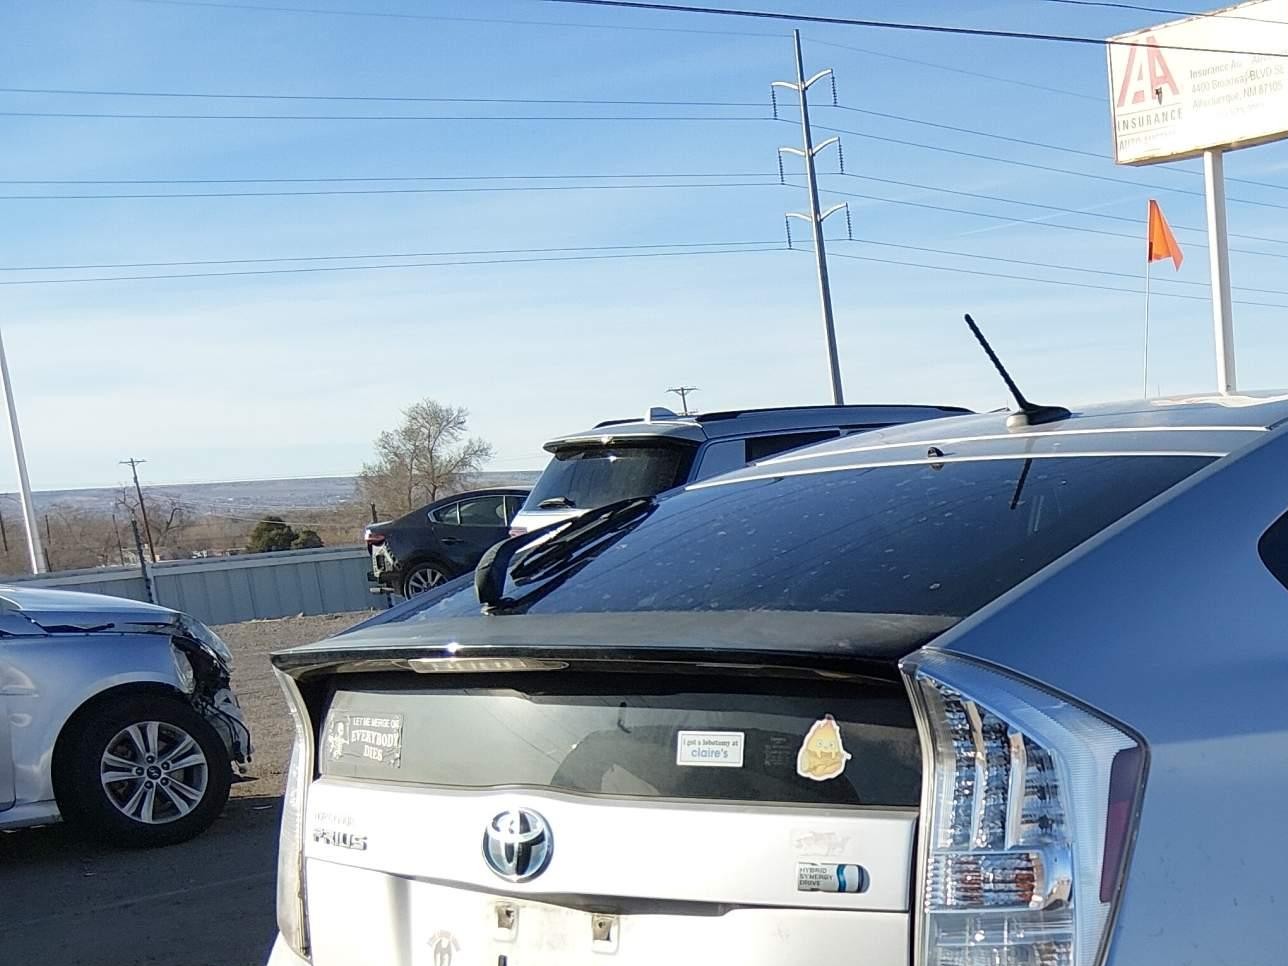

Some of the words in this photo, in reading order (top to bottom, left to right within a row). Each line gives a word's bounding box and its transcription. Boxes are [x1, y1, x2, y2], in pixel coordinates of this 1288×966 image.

[1189, 63, 1229, 80] Insurance
[1249, 66, 1273, 81] BLVD
[1243, 85, 1257, 97] NM
[1117, 107, 1183, 132] INSURANCE
[353, 717, 363, 726] LET
[351, 729, 399, 748] EVERYBODY
[687, 739, 697, 747] got
[702, 739, 730, 748] lobotomy
[363, 744, 383, 762] DIES
[691, 747, 729, 759] claire's
[313, 828, 368, 851] PRIUS
[800, 873, 833, 881] SYNERGY
